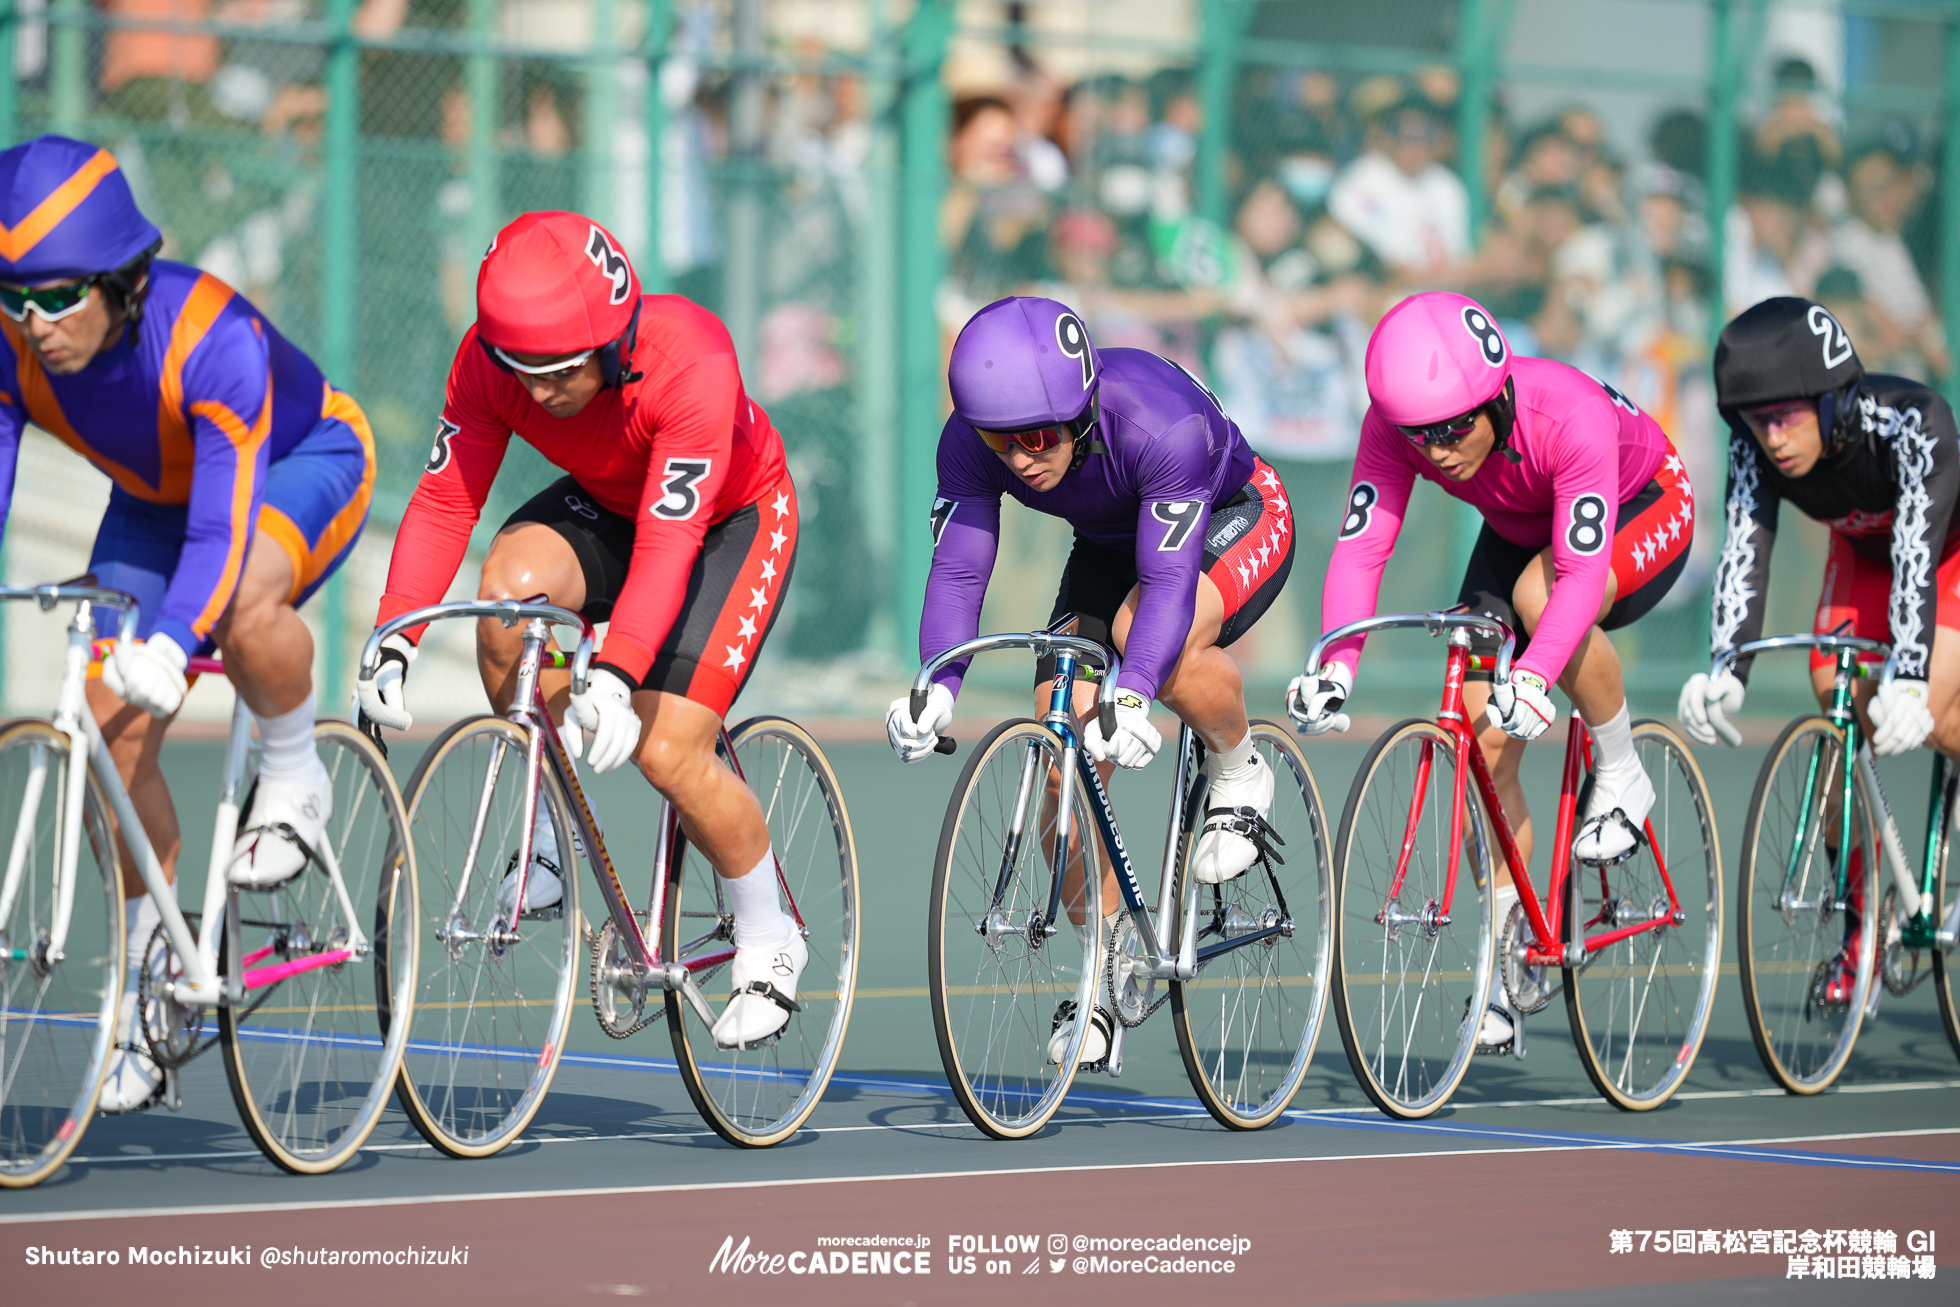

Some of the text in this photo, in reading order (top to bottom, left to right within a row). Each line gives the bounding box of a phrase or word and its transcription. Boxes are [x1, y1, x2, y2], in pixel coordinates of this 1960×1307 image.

[585, 224, 631, 305] 3
[1055, 312, 1096, 391] 9
[1460, 305, 1506, 368] 8
[1807, 304, 1853, 370] 2
[424, 414, 461, 474] 3
[649, 457, 711, 521] 3
[1338, 480, 1379, 541] 8
[1150, 499, 1205, 552] 9
[1565, 492, 1608, 556] 8
